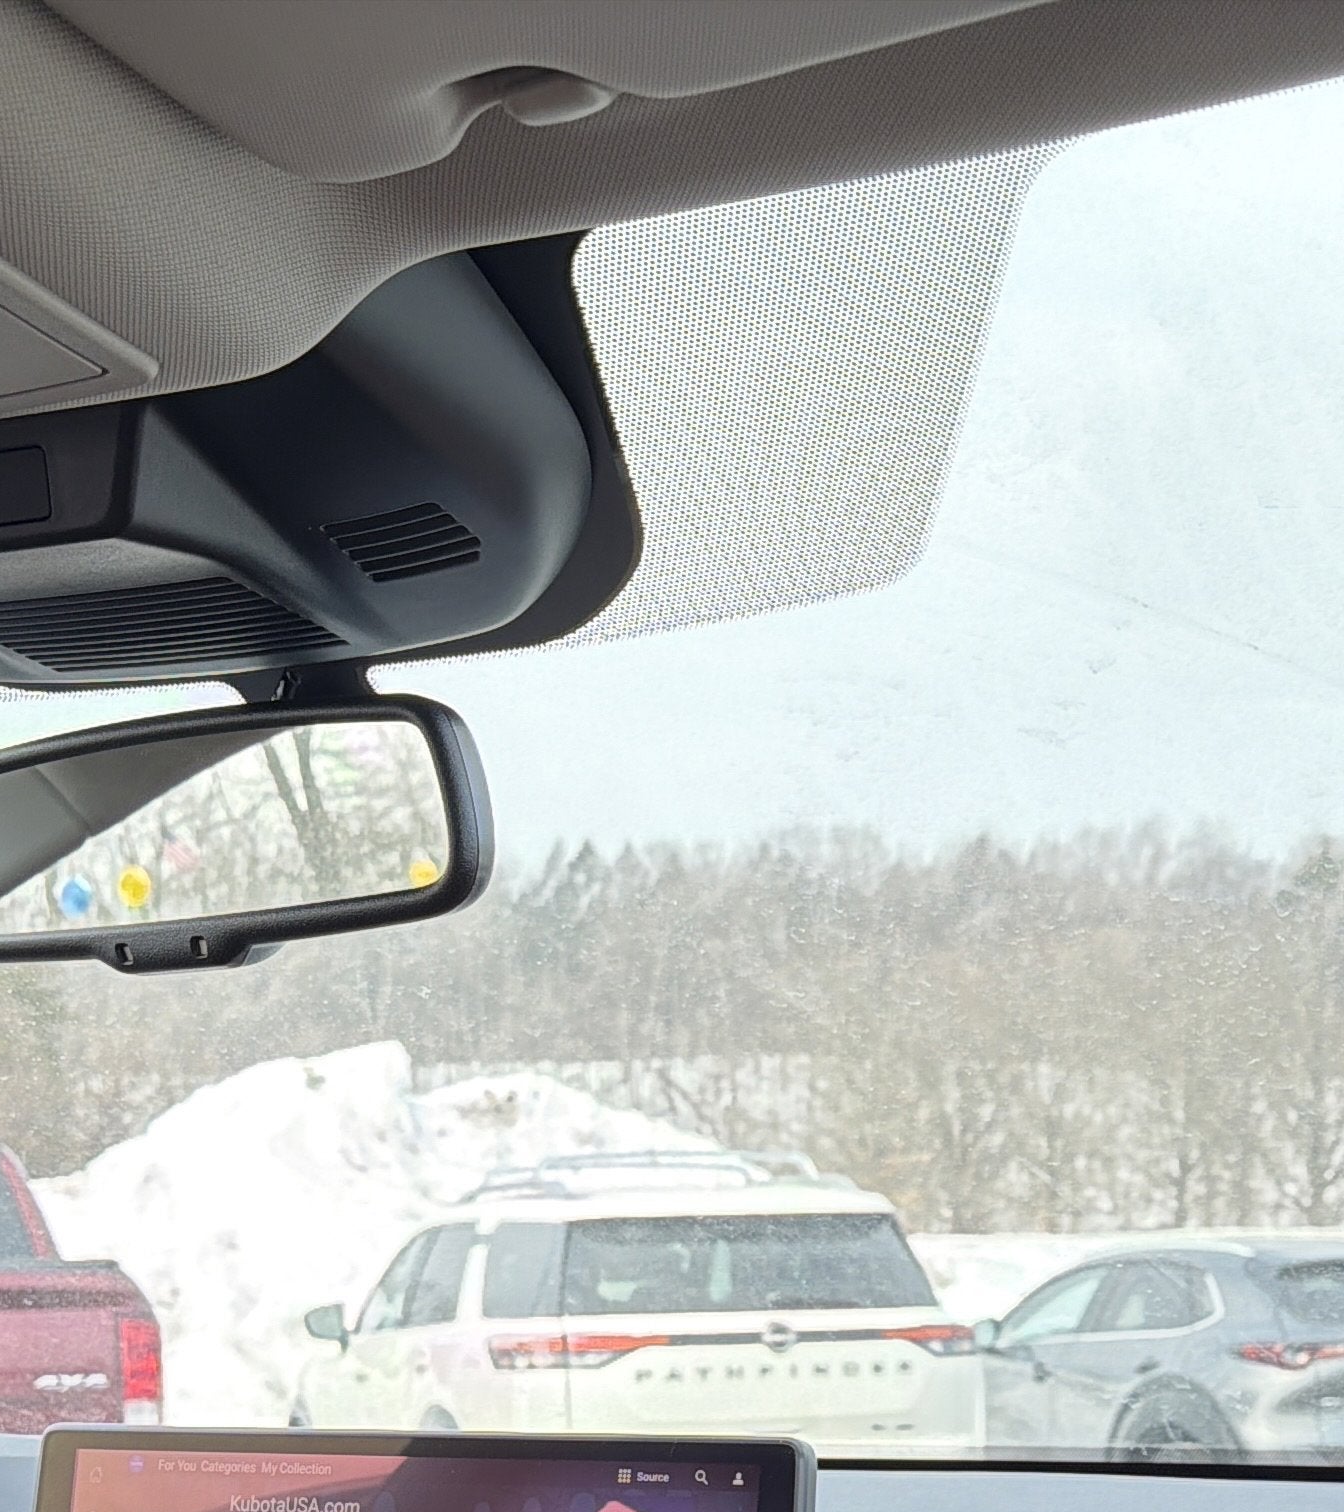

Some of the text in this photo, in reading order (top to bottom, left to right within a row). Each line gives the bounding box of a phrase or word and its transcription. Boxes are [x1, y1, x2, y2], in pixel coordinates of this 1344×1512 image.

[158, 1460, 175, 1471] For
[177, 1460, 197, 1472] You
[201, 1461, 256, 1475] Categories
[261, 1462, 278, 1476] My
[279, 1462, 332, 1476] Collection
[636, 1471, 670, 1483] Source
